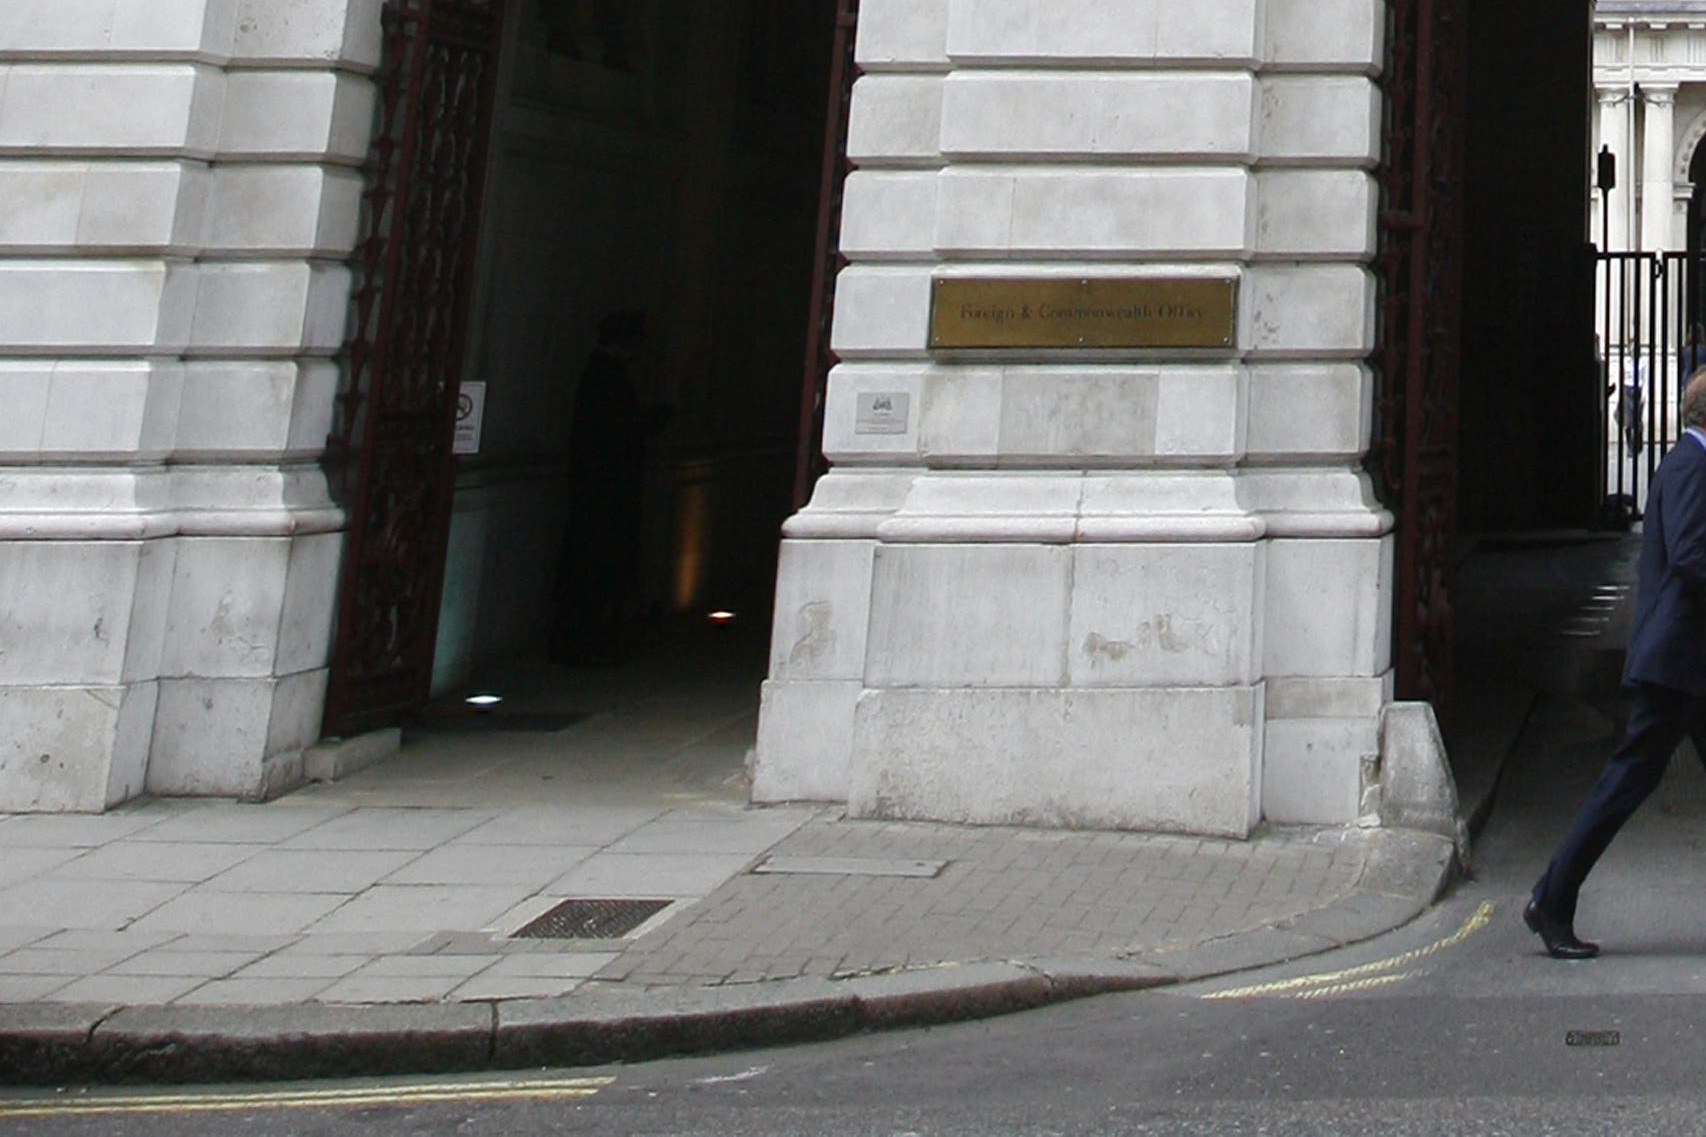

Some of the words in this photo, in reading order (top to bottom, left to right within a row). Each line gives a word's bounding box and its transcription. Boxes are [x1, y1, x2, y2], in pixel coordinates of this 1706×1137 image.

[960, 305, 1015, 323] Foreign
[1021, 305, 1032, 319] &
[1039, 303, 1152, 319] Commonwealth
[1158, 304, 1205, 319] Office
